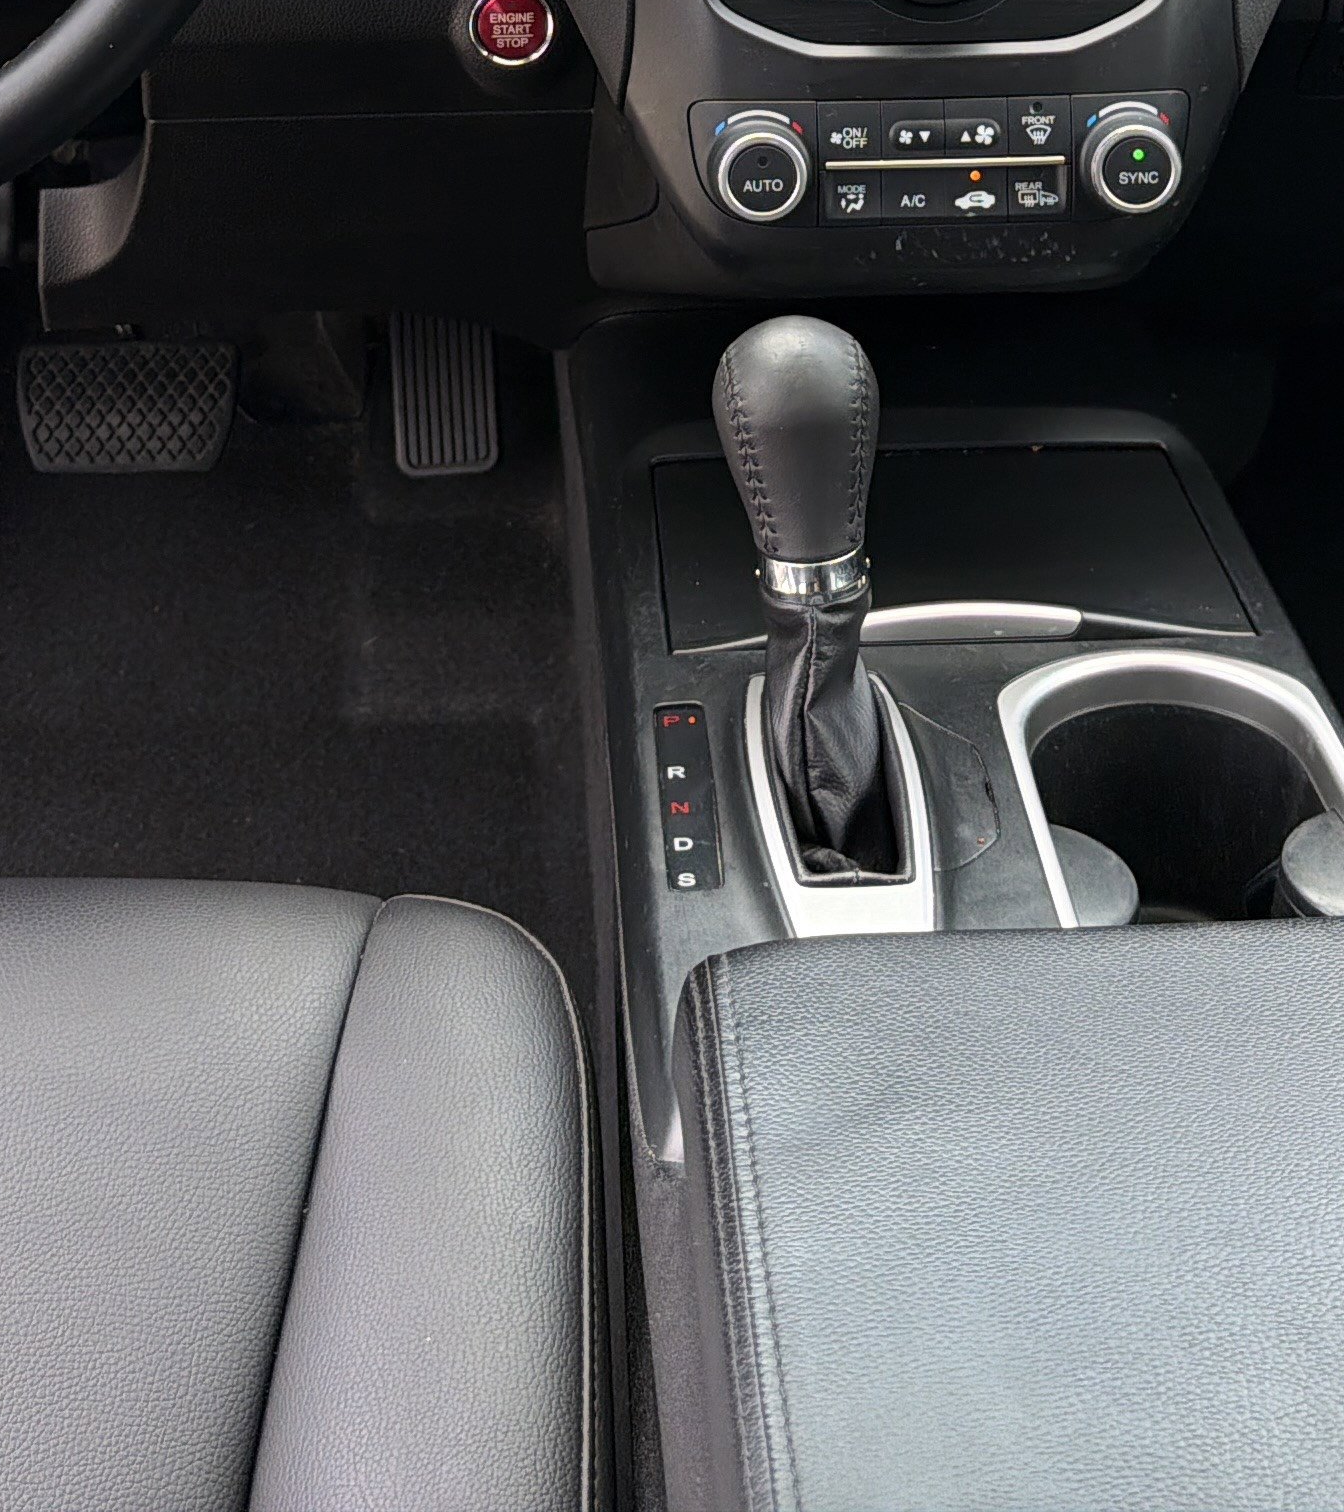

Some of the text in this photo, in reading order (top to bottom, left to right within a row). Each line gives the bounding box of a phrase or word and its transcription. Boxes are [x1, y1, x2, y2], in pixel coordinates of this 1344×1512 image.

[489, 12, 535, 24] ENGINE
[492, 23, 532, 35] START
[496, 37, 529, 48] STOP
[1021, 115, 1055, 125] FRONT
[842, 127, 867, 138] ON/
[842, 138, 868, 149] OFF
[1118, 170, 1159, 185] SYNC
[743, 179, 784, 193] AUTO
[837, 185, 866, 194] MODE
[1014, 181, 1043, 191] REAR
[900, 194, 926, 208] A/C
[663, 715, 681, 728] P
[666, 765, 686, 779] R
[670, 800, 690, 815] N
[673, 837, 694, 851] D
[677, 872, 697, 887] S
